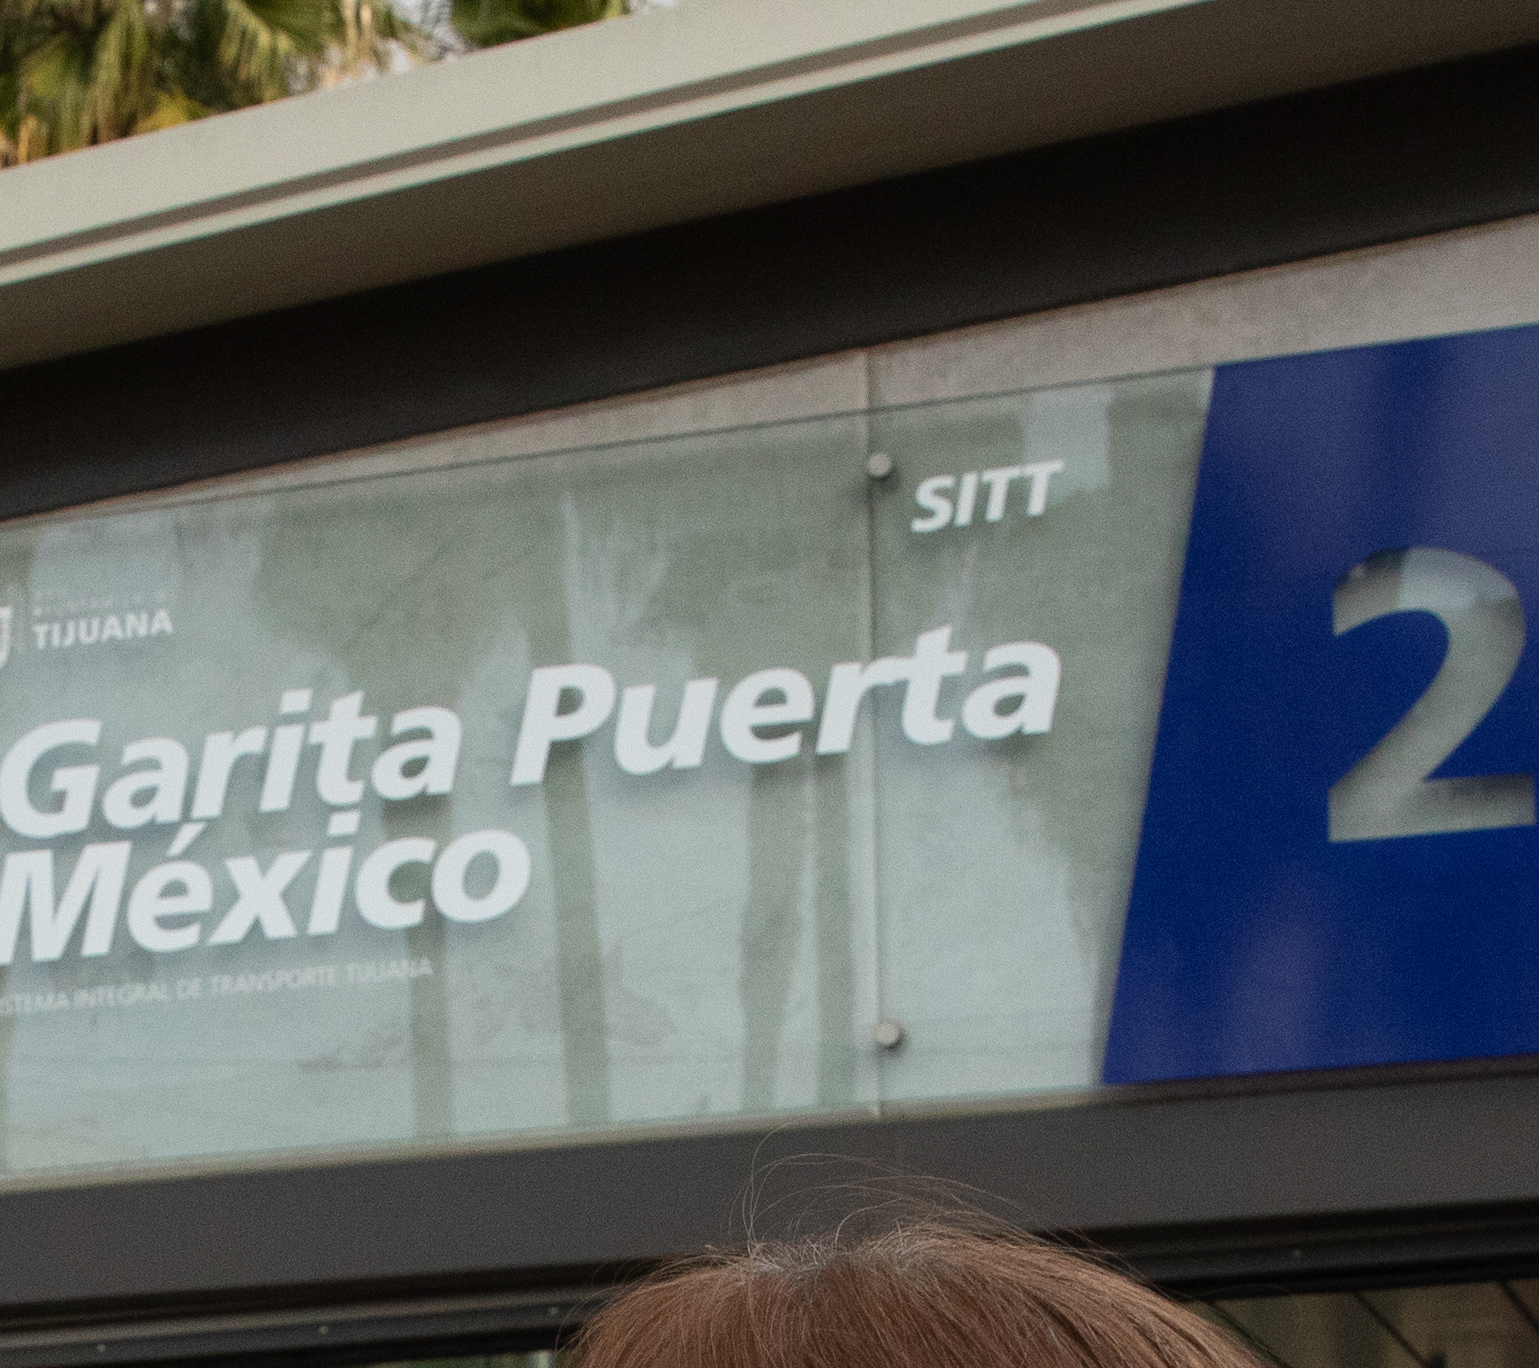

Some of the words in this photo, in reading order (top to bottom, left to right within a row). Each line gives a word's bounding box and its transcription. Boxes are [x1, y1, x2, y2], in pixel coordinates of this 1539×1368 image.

[910, 459, 1065, 532] SITT
[32, 608, 172, 650] TIJUANA
[510, 625, 1063, 786] Puerta
[175, 976, 202, 1002] DE
[209, 965, 336, 997] TRANSPORTE
